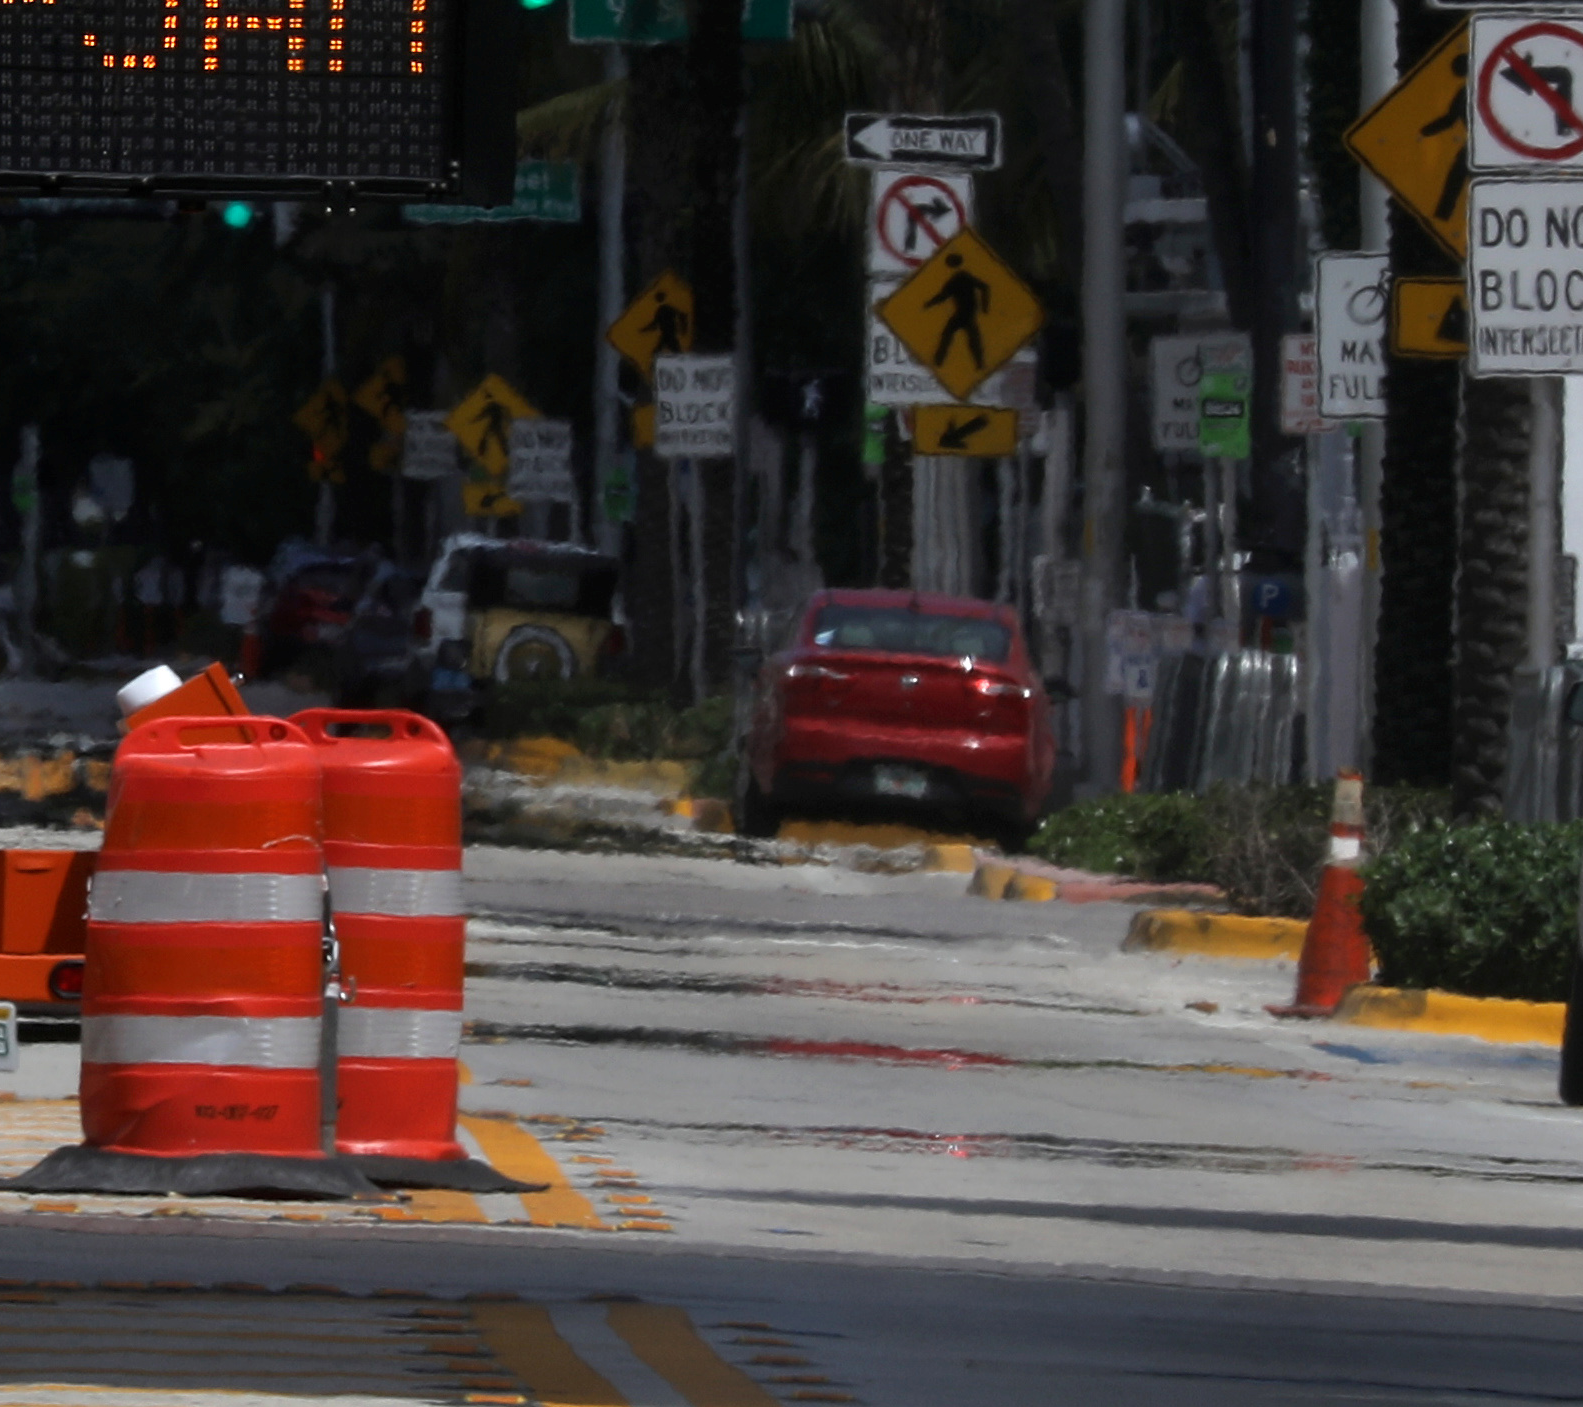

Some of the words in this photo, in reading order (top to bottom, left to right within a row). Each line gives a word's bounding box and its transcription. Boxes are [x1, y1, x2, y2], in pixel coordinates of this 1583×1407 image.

[891, 130, 932, 149] ONE
[939, 131, 980, 153] WAY
[1480, 206, 1529, 248] DO
[1341, 339, 1378, 366] MA
[658, 367, 687, 392] DO
[1329, 374, 1379, 400] FUL
[659, 400, 732, 424] BLOCK
